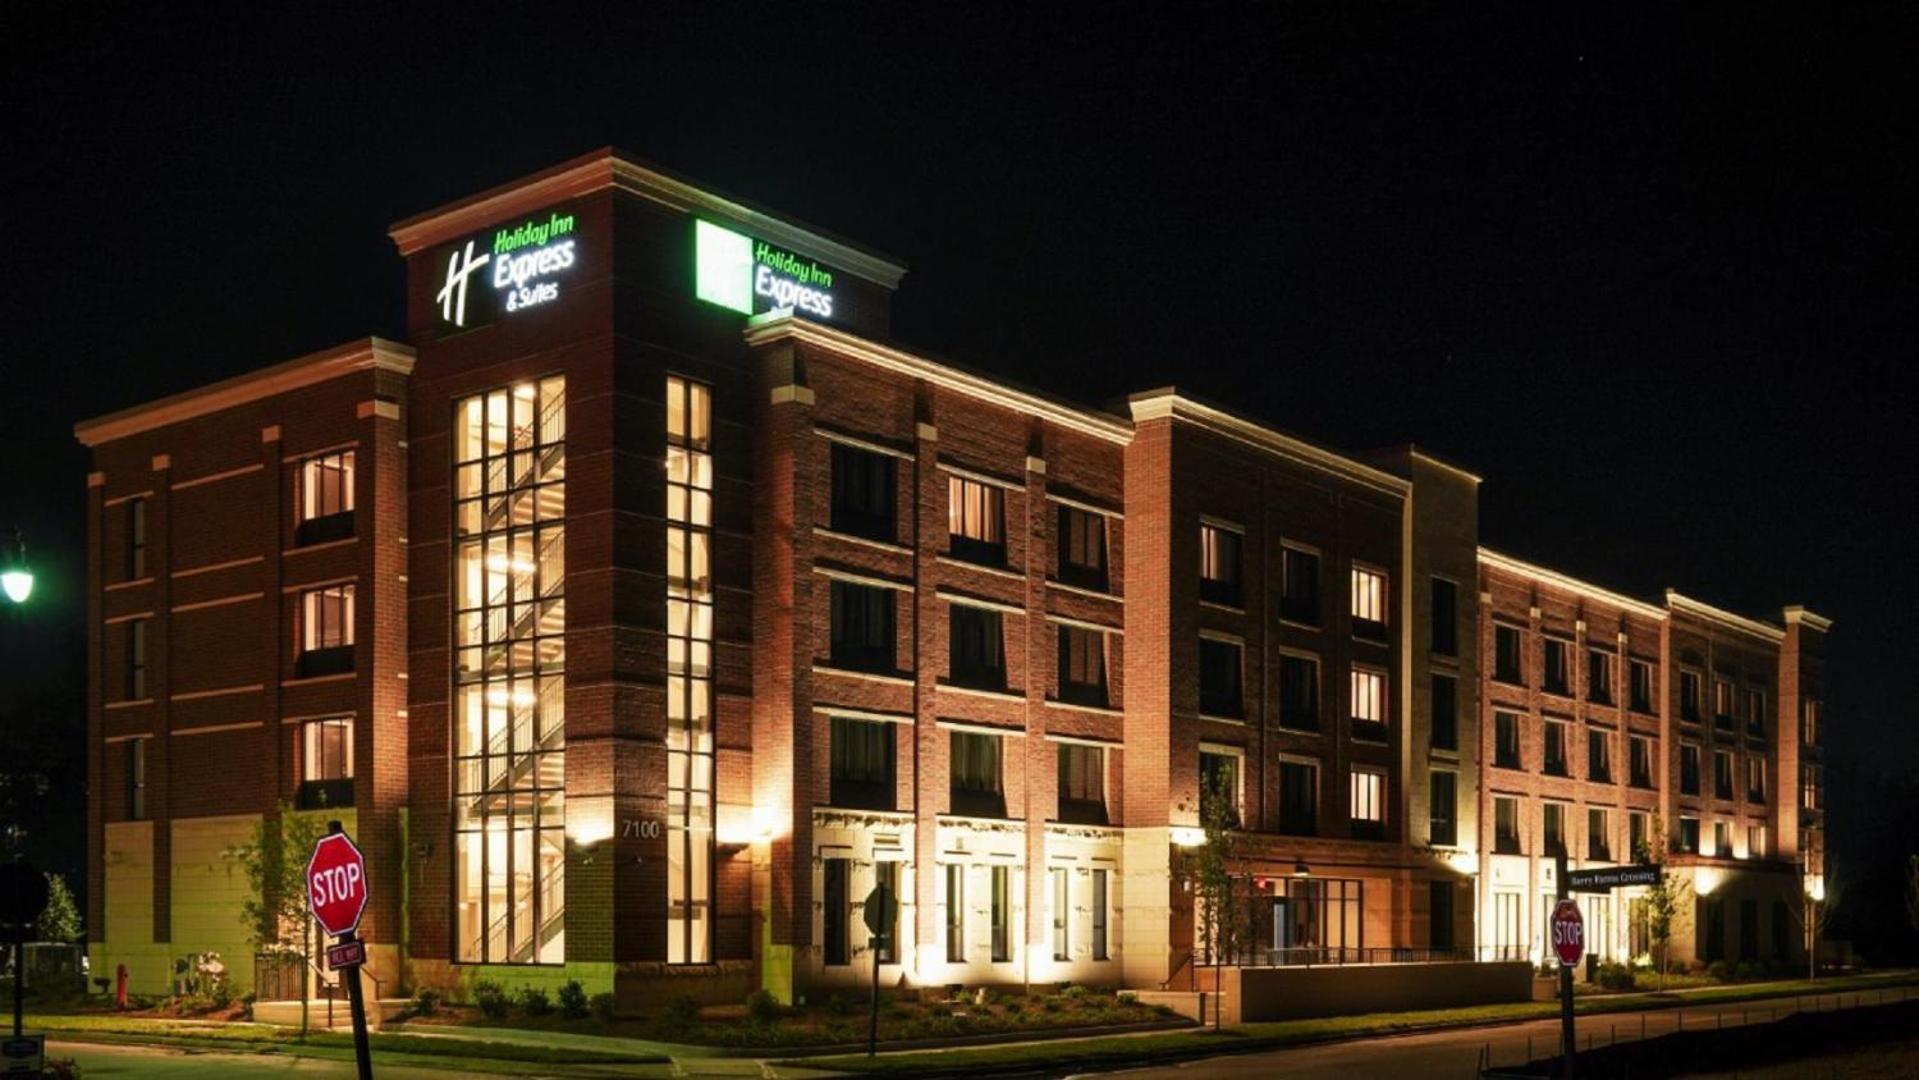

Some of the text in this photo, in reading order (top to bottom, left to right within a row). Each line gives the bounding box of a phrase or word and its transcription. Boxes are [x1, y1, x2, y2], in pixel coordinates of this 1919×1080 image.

[494, 213, 574, 255] Holiday Inn
[494, 240, 575, 289] Express
[756, 242, 833, 288] Holiday Inn
[506, 283, 558, 312] & Suites
[755, 264, 833, 317] Express
[623, 820, 660, 839] 7100
[313, 862, 360, 907] STOP
[1555, 921, 1582, 945] STOP
